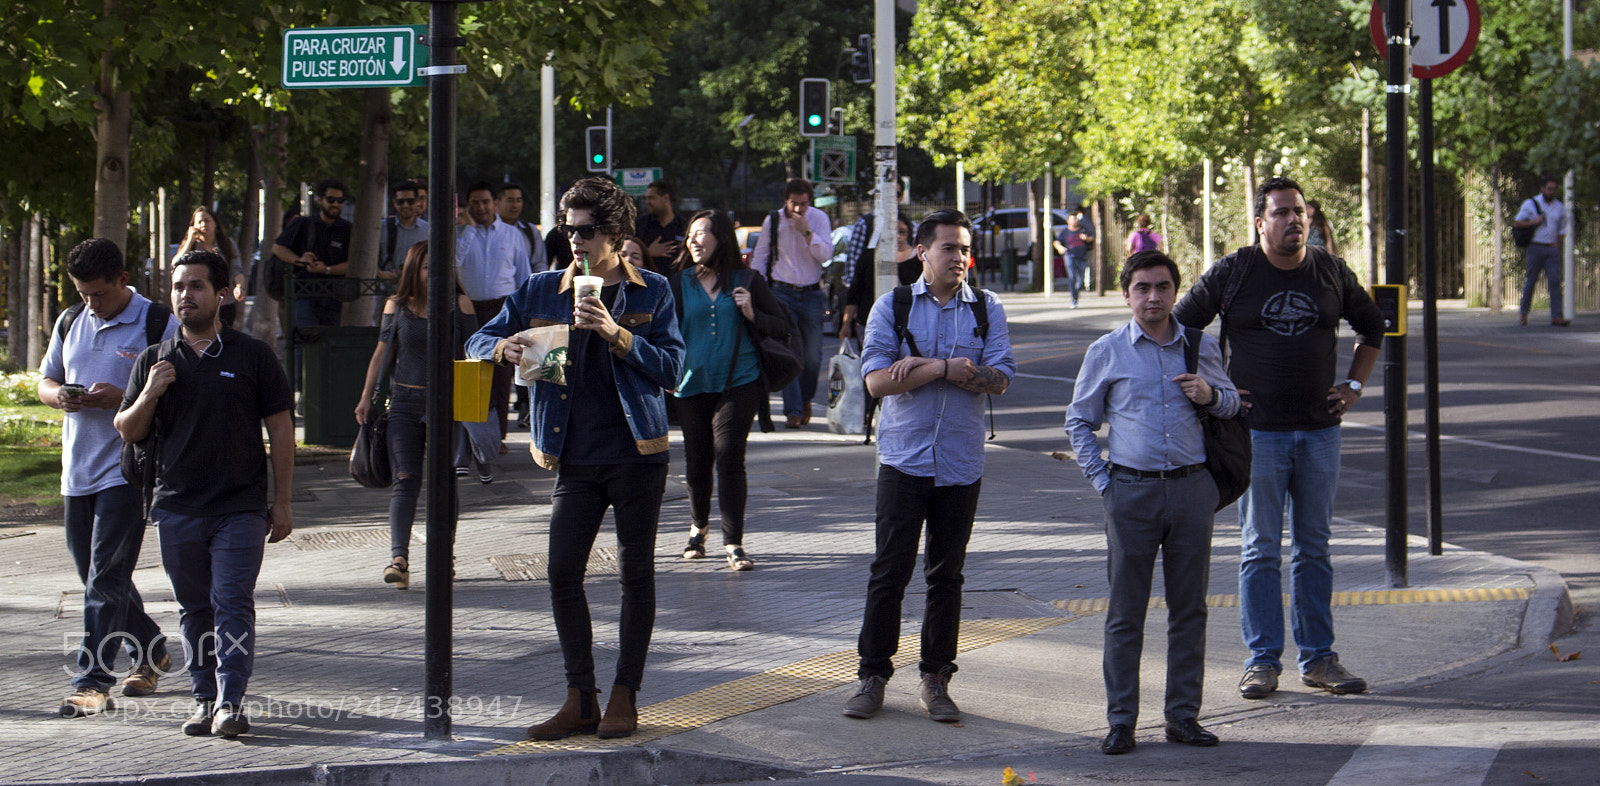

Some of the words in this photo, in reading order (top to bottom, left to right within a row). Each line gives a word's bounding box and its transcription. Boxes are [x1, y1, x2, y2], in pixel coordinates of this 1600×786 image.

[293, 39, 330, 55] PARA
[331, 37, 386, 54] CRUZAR
[292, 60, 336, 77] PULSE
[339, 56, 386, 76] BOTÓN
